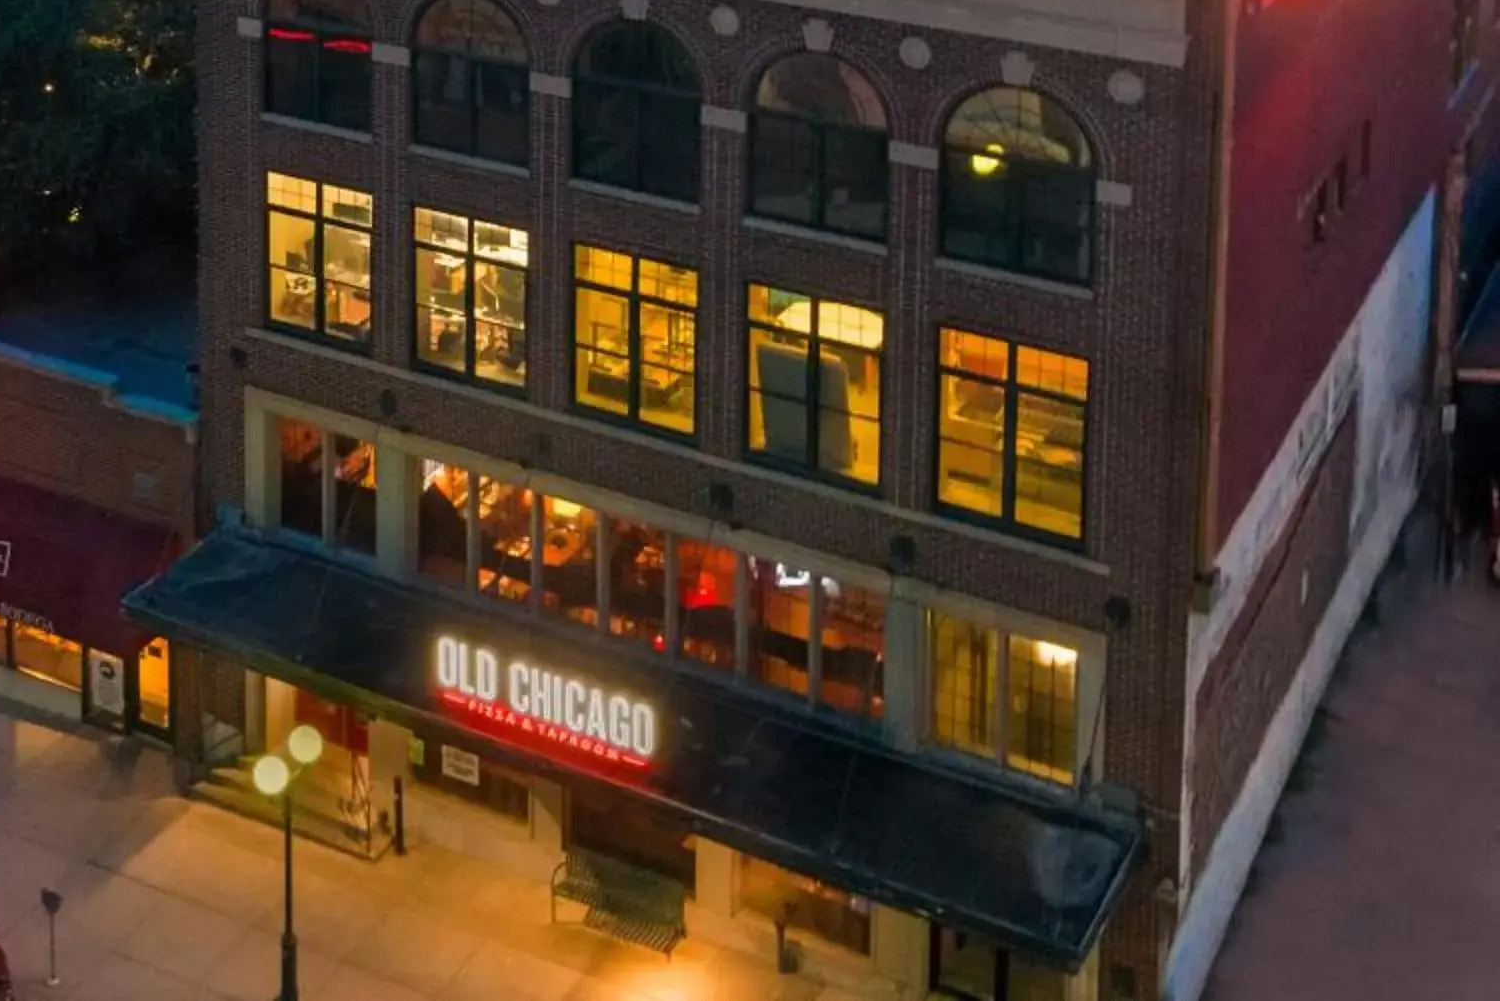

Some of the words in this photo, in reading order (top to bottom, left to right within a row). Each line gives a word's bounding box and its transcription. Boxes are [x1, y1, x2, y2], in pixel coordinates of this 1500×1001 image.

[436, 636, 498, 700] OLD
[508, 662, 655, 754] CHICAGO
[467, 700, 516, 726] PIZZA
[521, 717, 534, 732] &
[536, 722, 620, 761] TAPROOM
